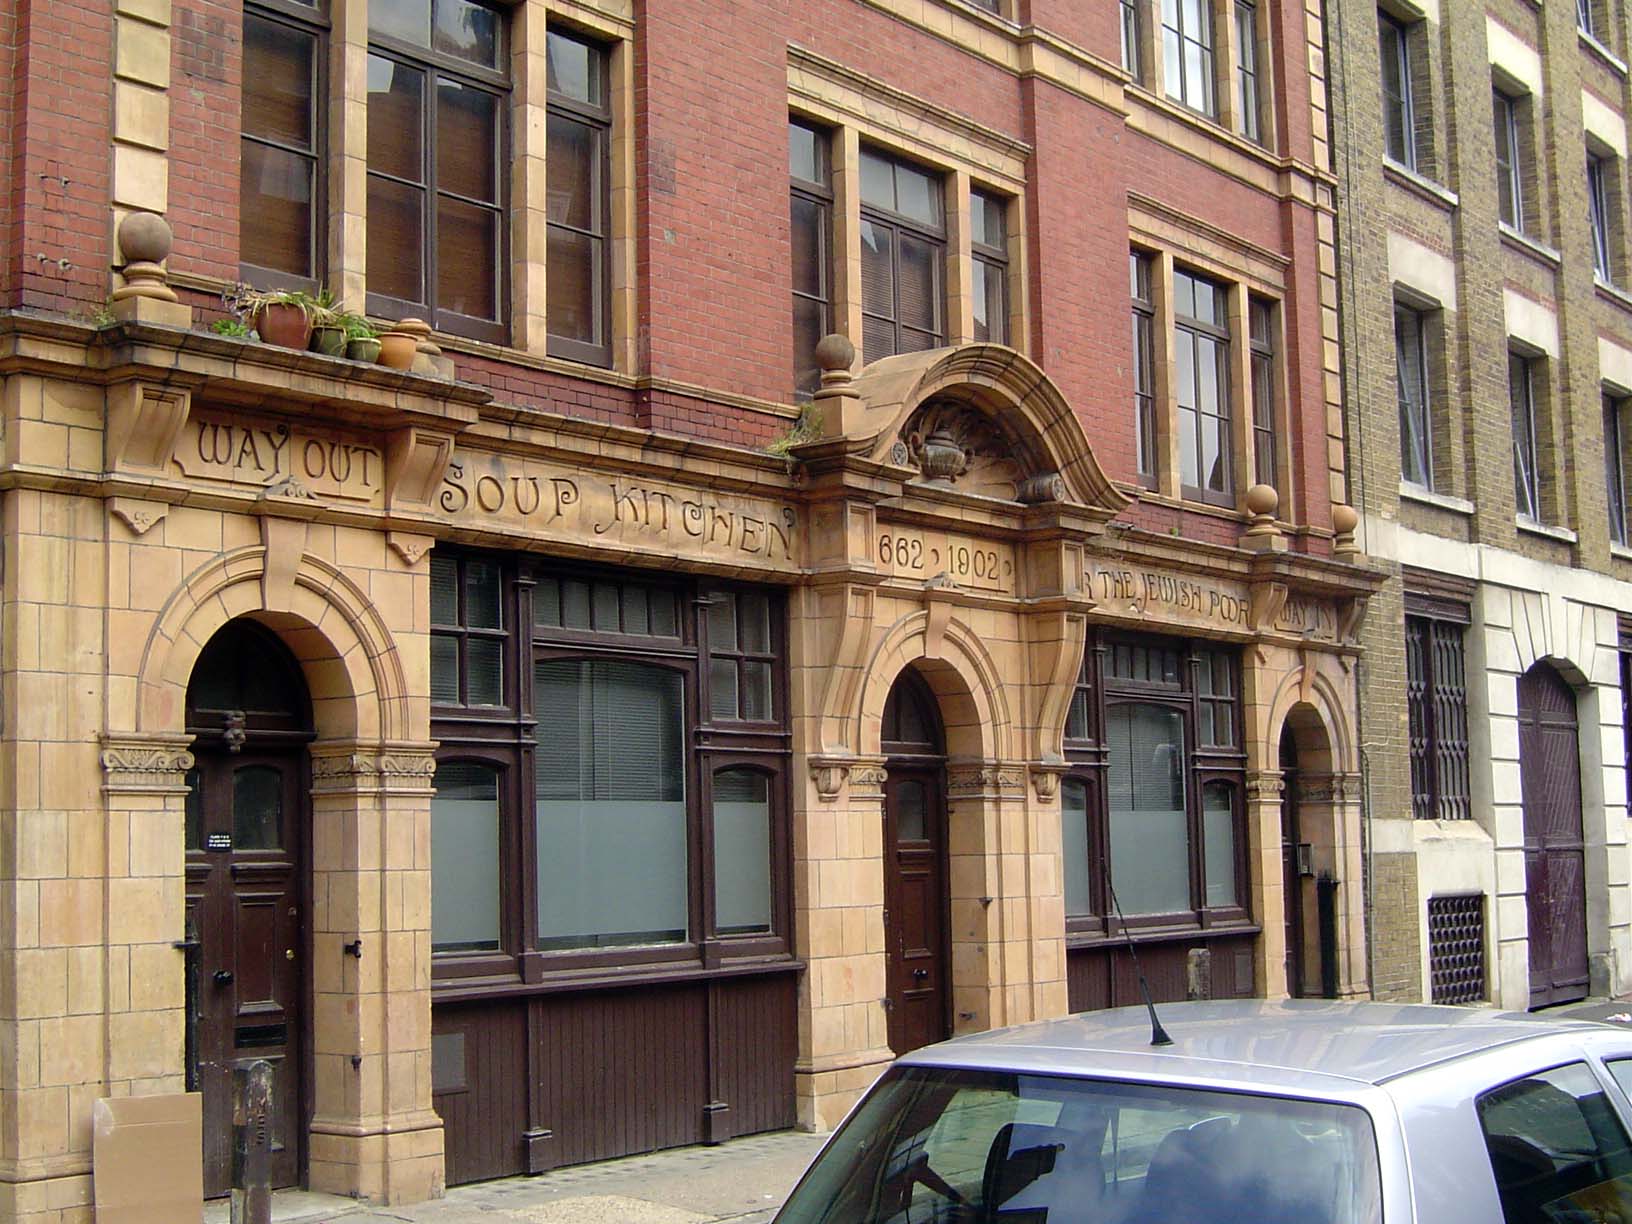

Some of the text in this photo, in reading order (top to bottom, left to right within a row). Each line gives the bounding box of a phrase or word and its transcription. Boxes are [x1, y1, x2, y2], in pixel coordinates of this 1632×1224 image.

[198, 422, 379, 487] WAY OUT
[440, 463, 795, 561] SOUP KITCHEN
[1098, 571, 1136, 599] THE
[1130, 572, 1201, 613] JEWISH
[1208, 590, 1251, 629] POOR
[1279, 601, 1333, 631] WAY IN
